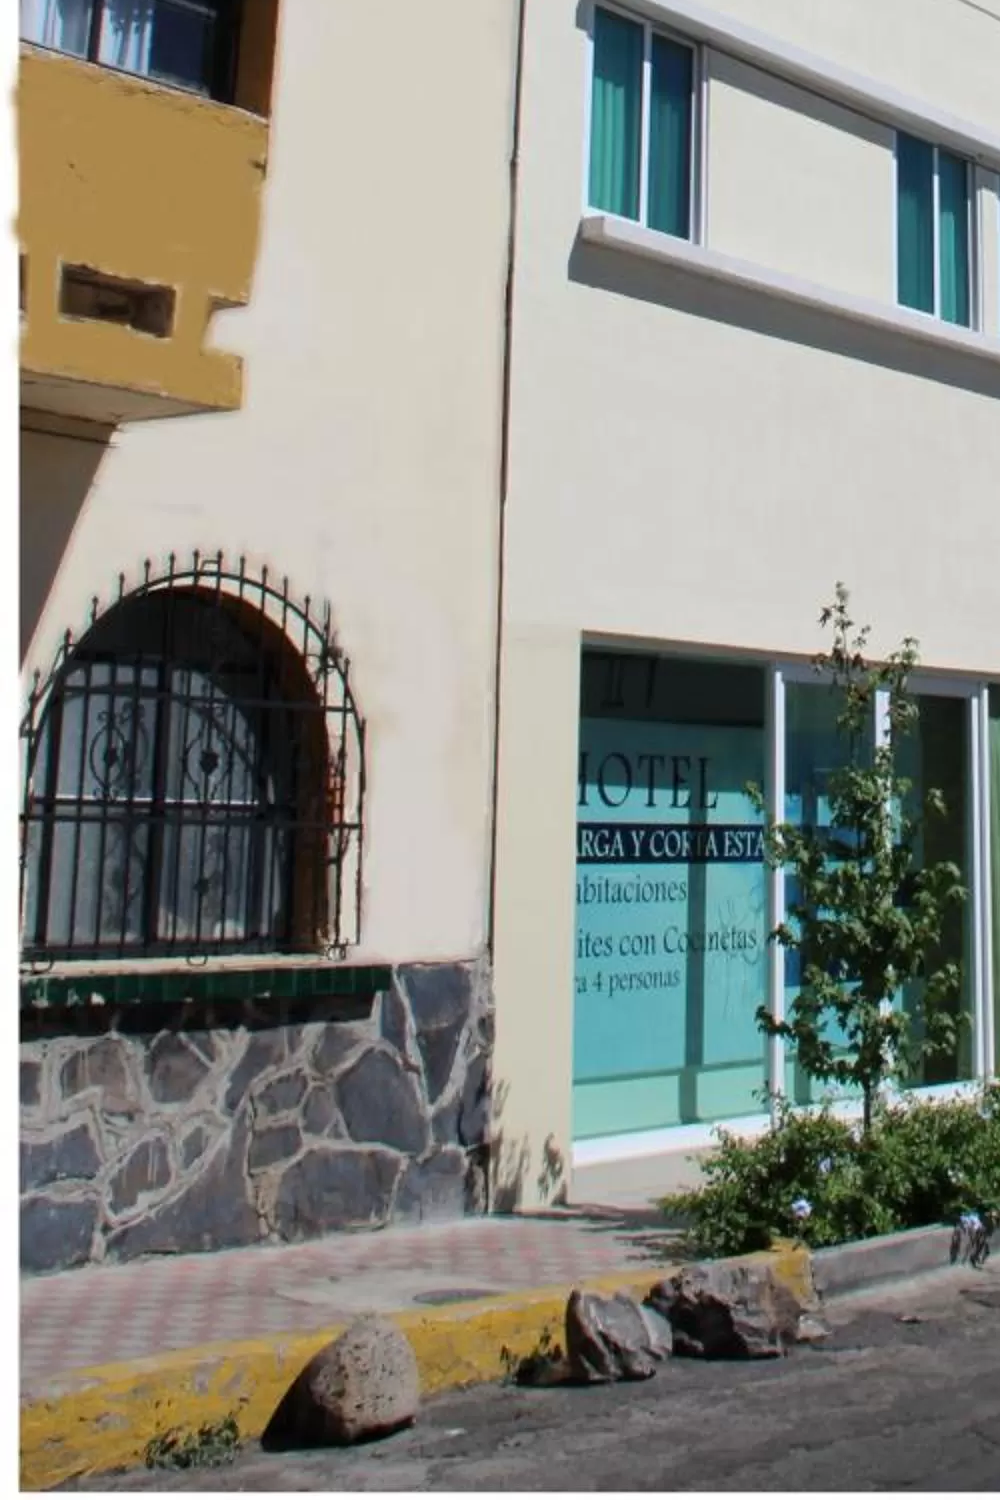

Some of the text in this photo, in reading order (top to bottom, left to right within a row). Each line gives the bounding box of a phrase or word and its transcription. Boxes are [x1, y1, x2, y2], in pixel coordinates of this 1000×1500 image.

[576, 829, 625, 858] RGA
[630, 830, 646, 858] Y
[618, 932, 657, 957] con
[591, 970, 602, 993] 4
[607, 968, 682, 998] personas
